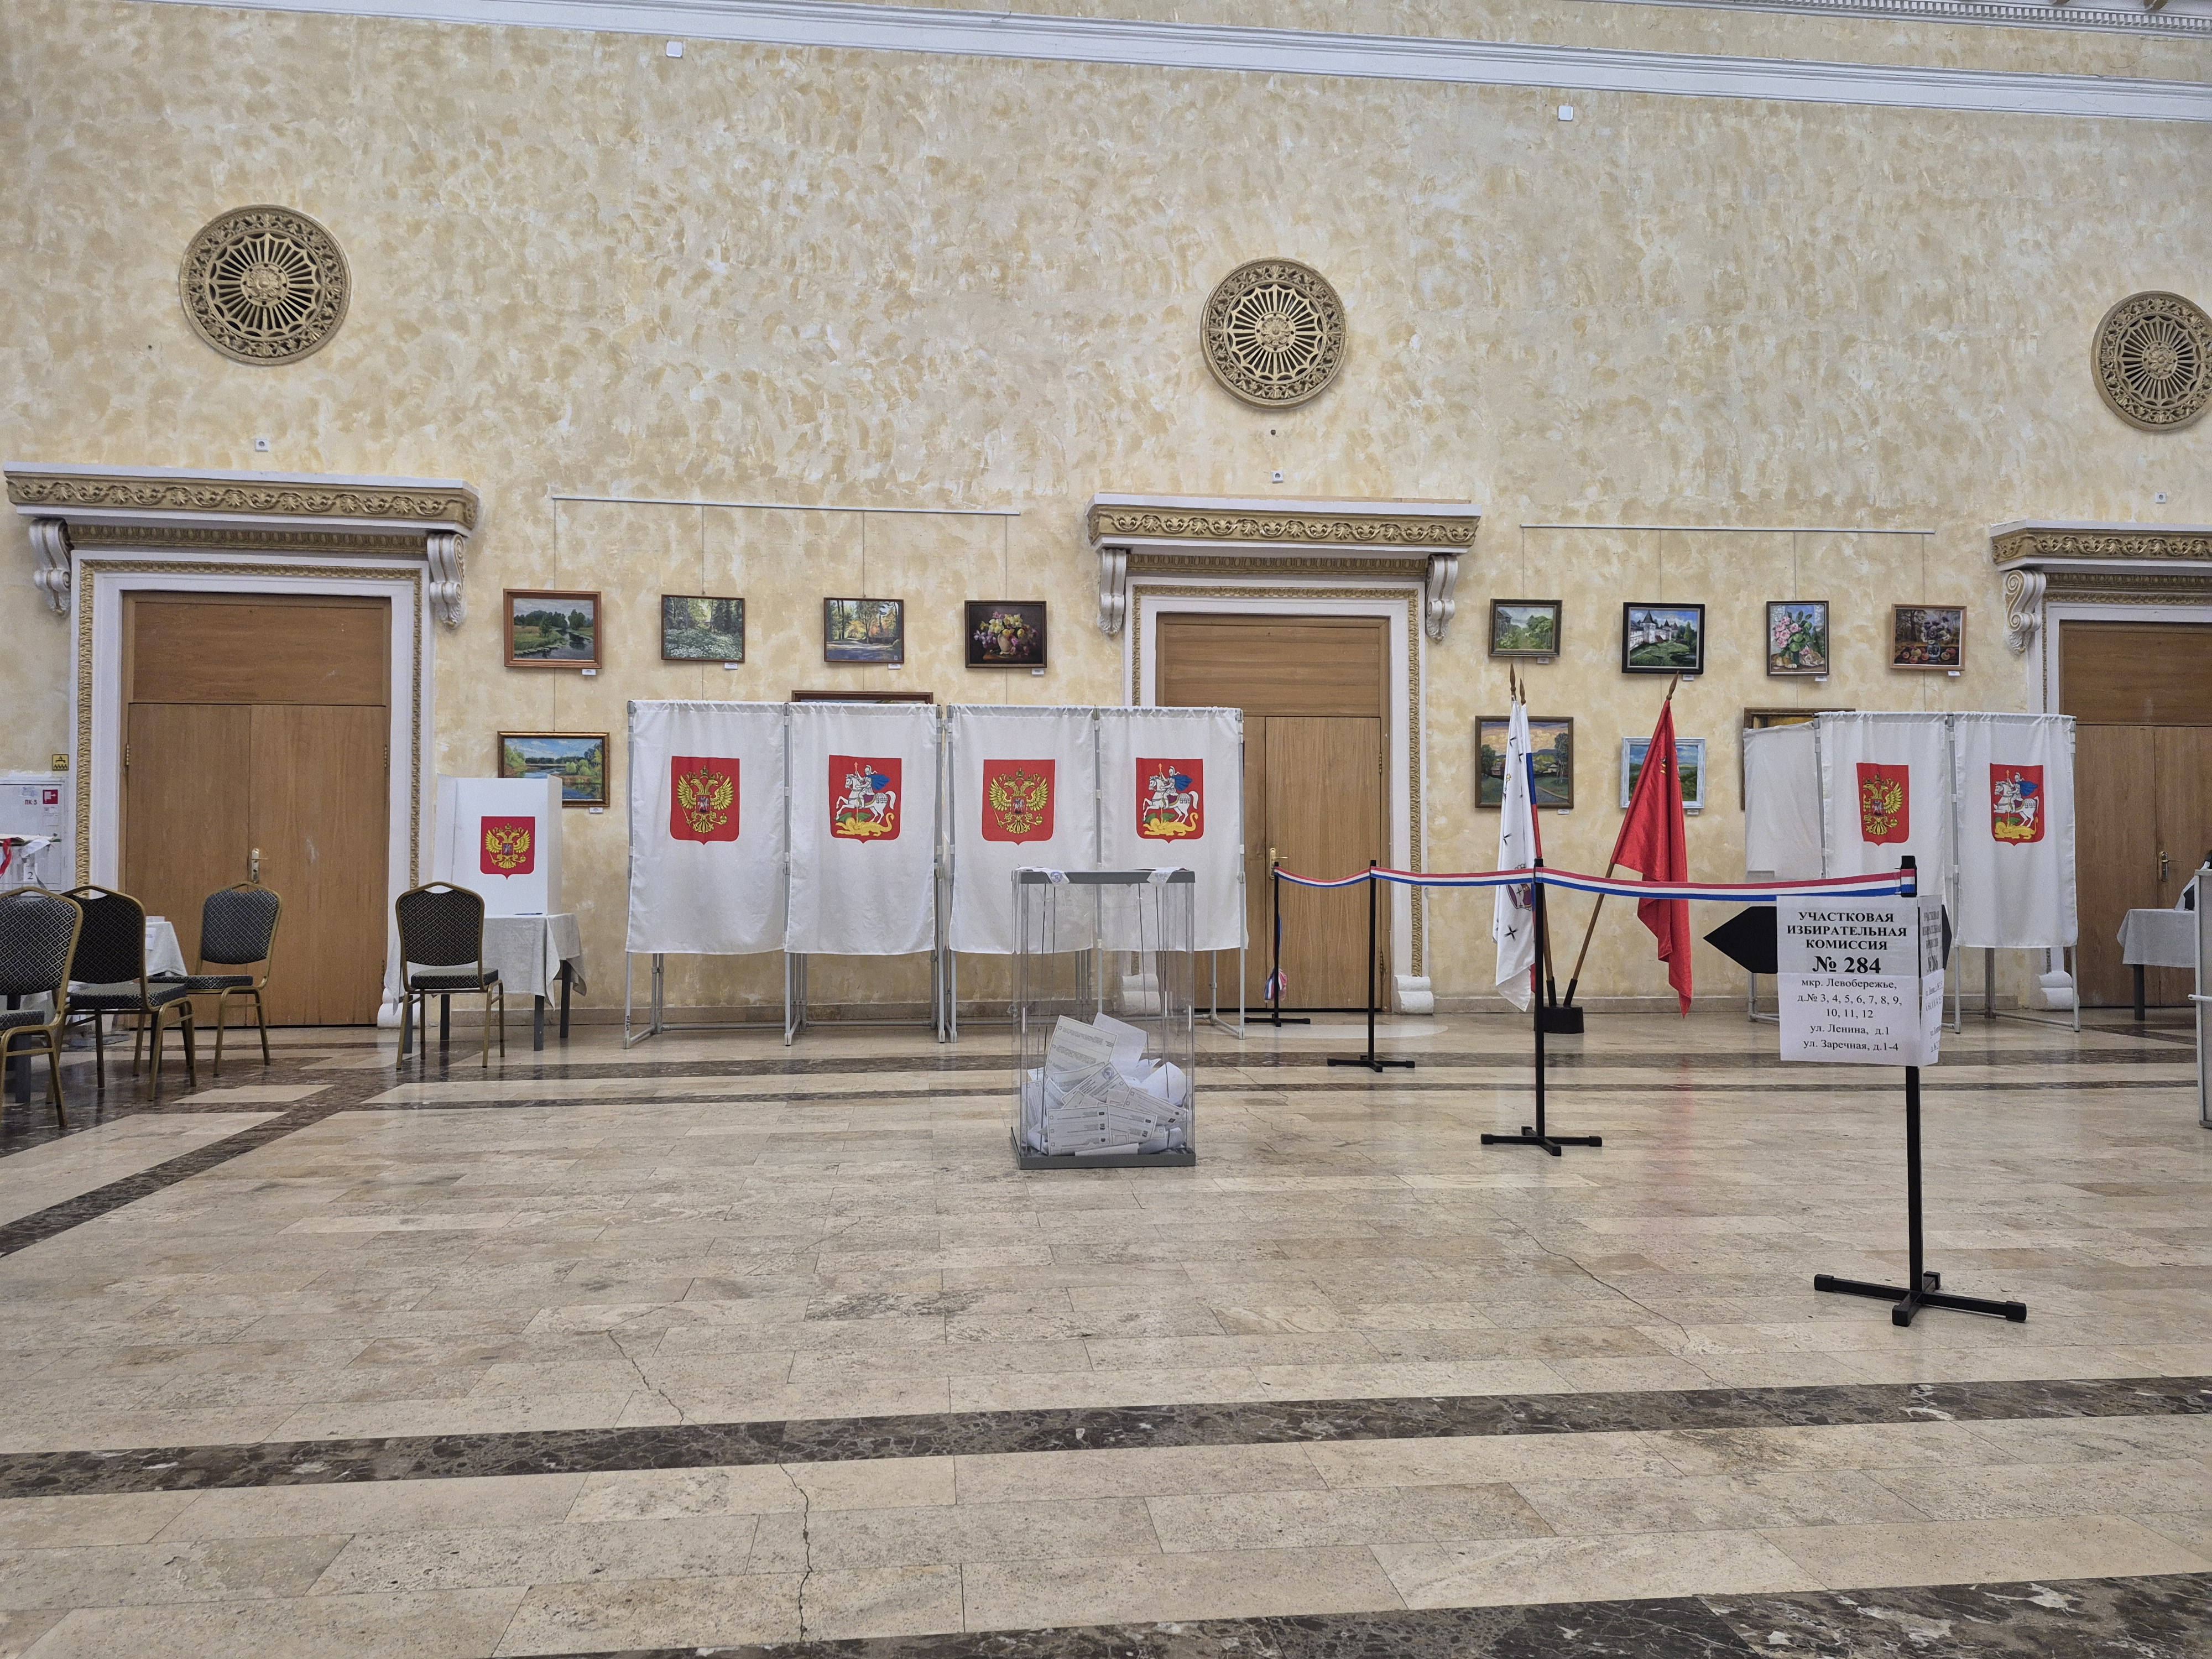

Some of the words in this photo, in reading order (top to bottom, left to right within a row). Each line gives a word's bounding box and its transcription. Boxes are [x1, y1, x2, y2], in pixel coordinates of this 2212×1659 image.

[1798, 912, 1894, 922] УЧАСТКОВАЯ
[1787, 925, 1907, 936] ИЗБИРАТЕЛЬНАЯ
[1806, 939, 1887, 950] КОМИССИЯ
[1812, 956, 1837, 972] №
[1844, 957, 1881, 974] 284
[1802, 979, 1823, 988] мкр.
[1826, 978, 1897, 989] Левобережье,
[1797, 993, 1818, 1002] д.№
[1820, 994, 1829, 1003] 3,
[1832, 994, 1841, 1004] 4,
[1844, 995, 1853, 1004] 5,
[1856, 995, 1865, 1004] 6,
[1869, 995, 1877, 1005] 7,
[1881, 996, 1890, 1005] 8,
[1893, 996, 1902, 1006] 9,
[1827, 1008, 1840, 1018] 10,
[1844, 1009, 1858, 1019] 11,
[1863, 1010, 1874, 1018] 12
[1810, 1025, 1824, 1034] ул.
[1828, 1024, 1869, 1035] Ленина,
[1875, 1027, 1889, 1035] д.1
[1803, 1040, 1818, 1048] ул.
[1821, 1040, 1870, 1051] Заречная,
[1873, 1042, 1898, 1051] д.1-4
